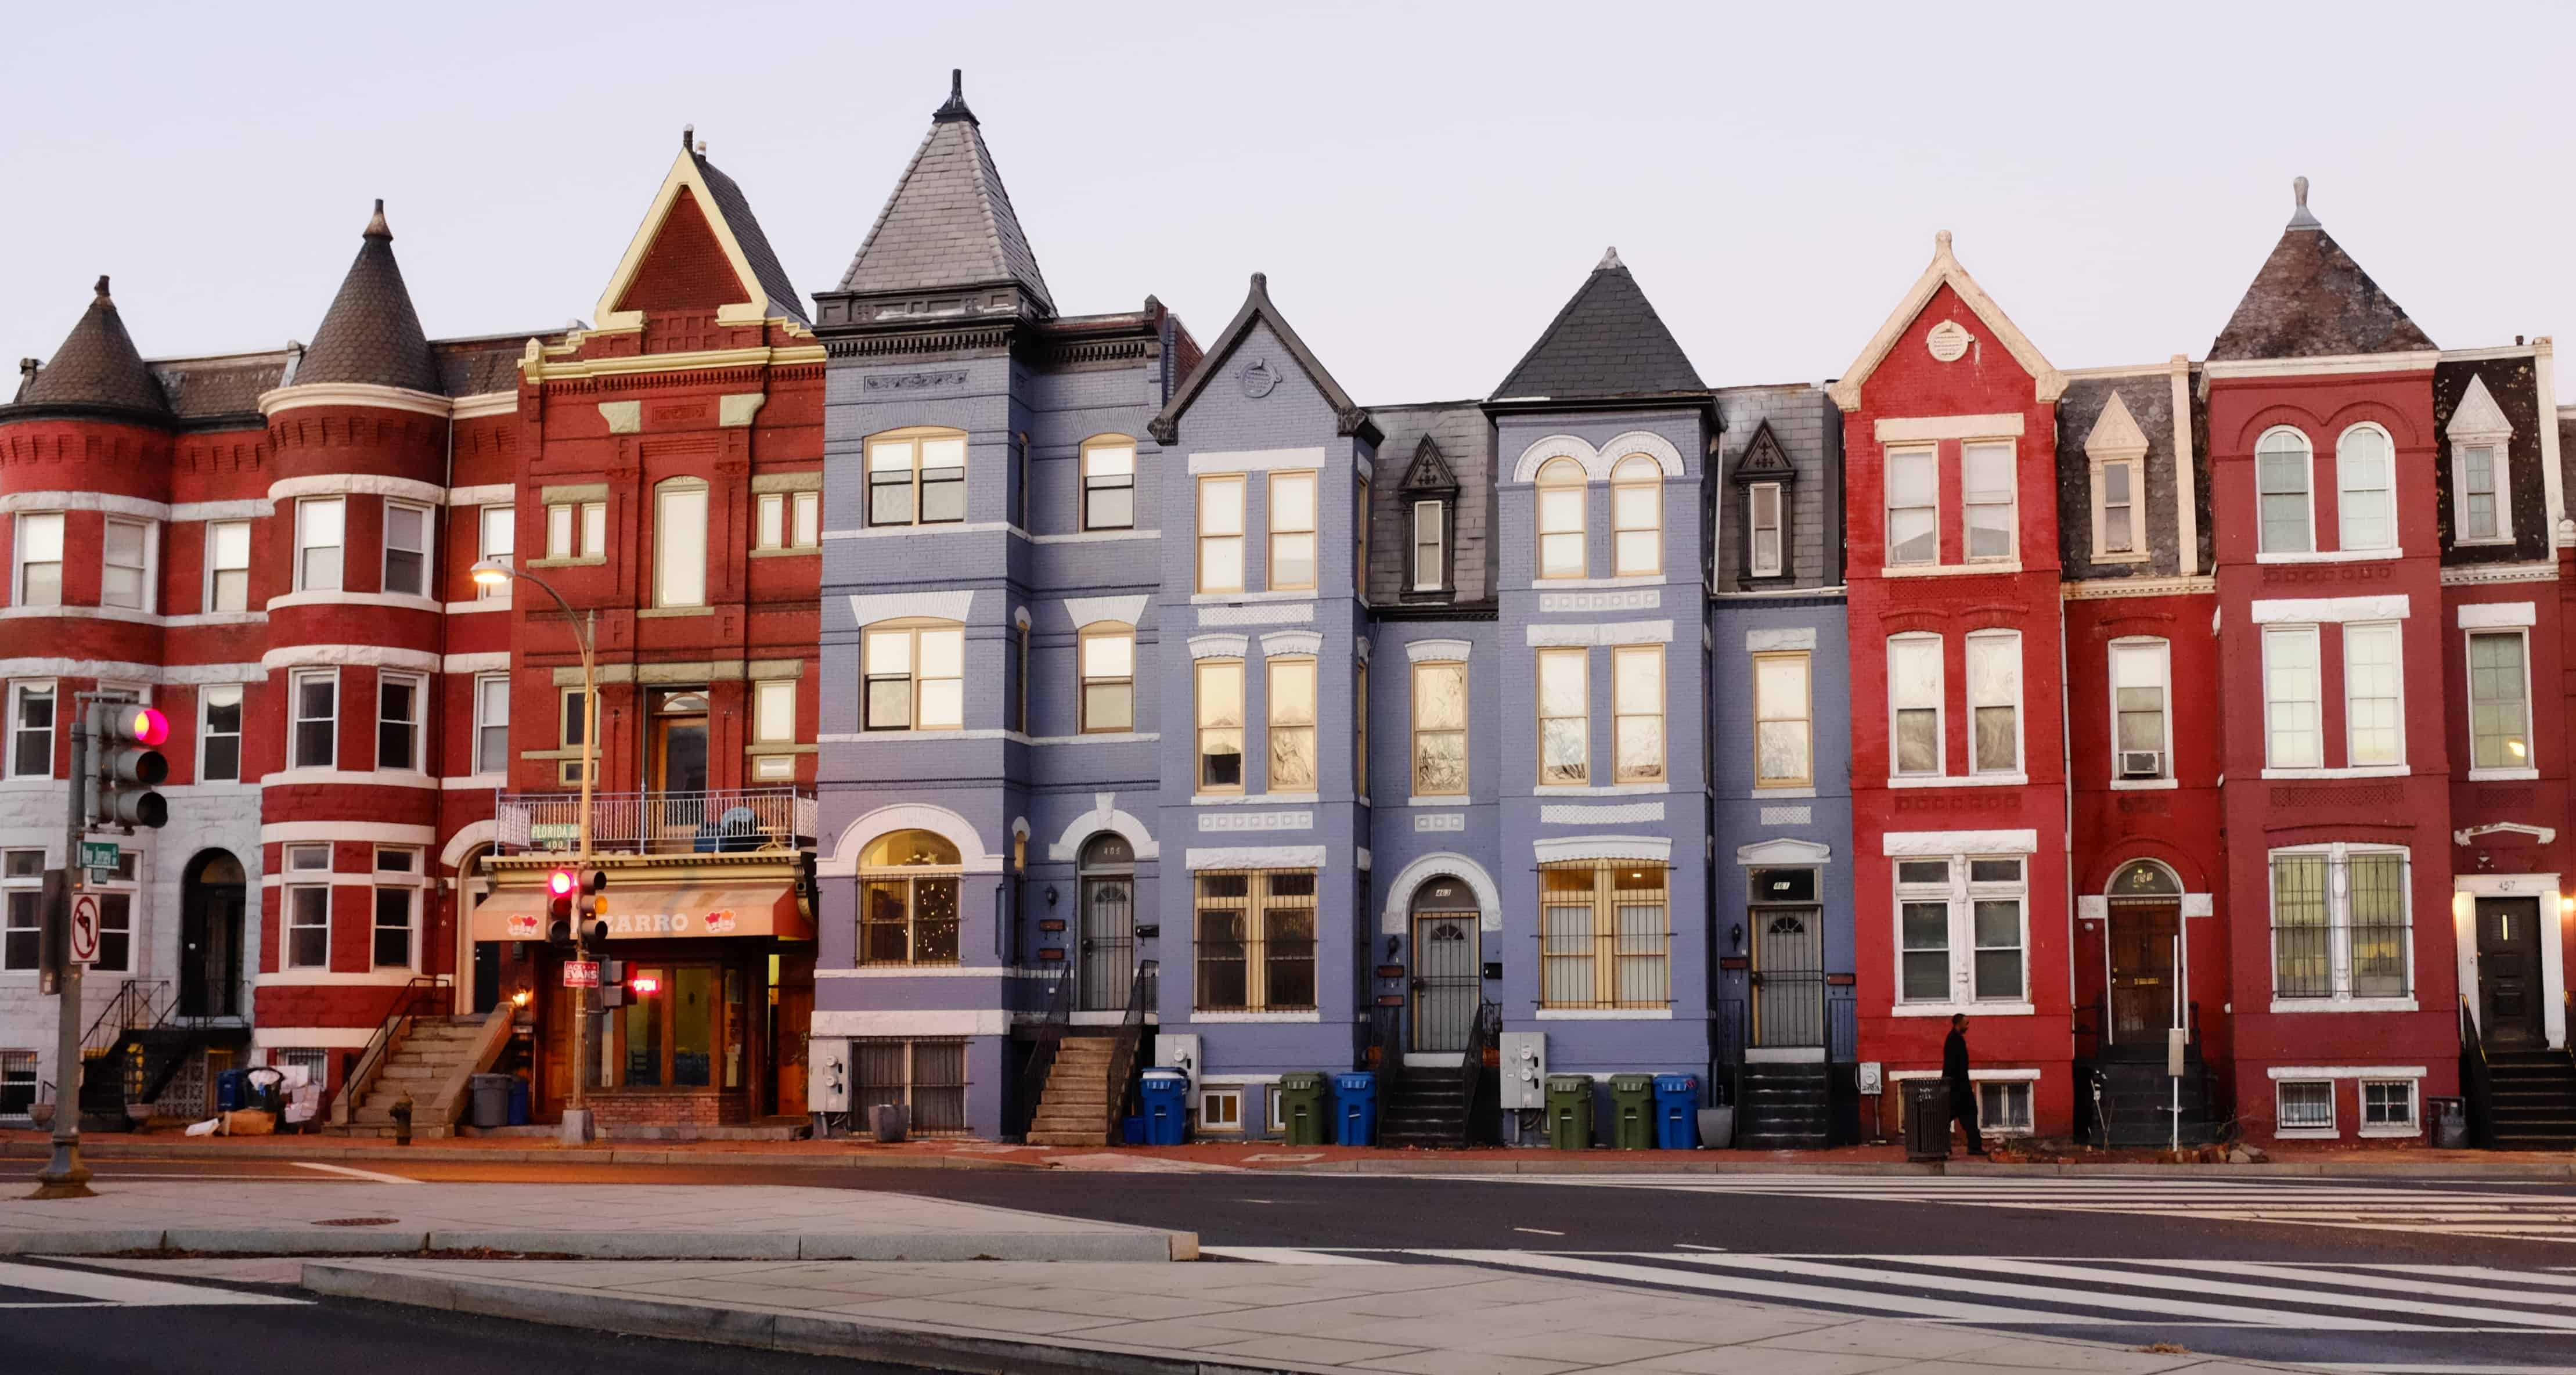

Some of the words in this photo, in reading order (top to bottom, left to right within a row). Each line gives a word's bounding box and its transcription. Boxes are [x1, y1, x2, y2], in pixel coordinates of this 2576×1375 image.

[532, 826, 567, 837] FLORIDA
[566, 971, 597, 979] EVANS
[633, 980, 656, 991] OPEN
